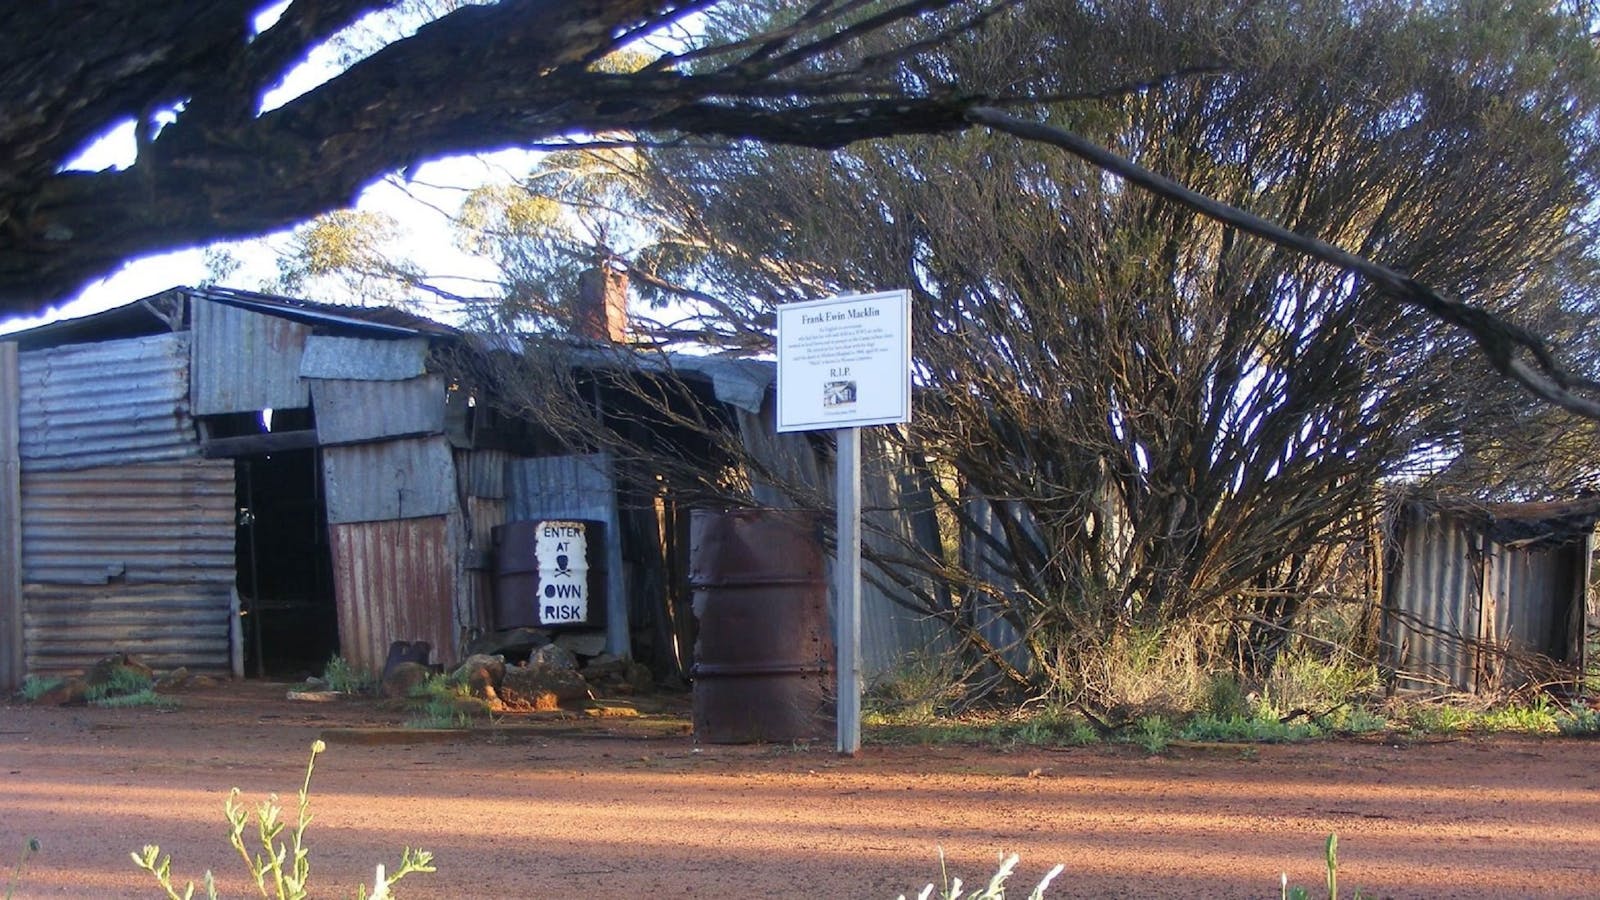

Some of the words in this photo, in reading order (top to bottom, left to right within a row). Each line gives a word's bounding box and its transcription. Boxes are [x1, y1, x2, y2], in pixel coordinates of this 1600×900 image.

[802, 313, 824, 325] Frank
[826, 311, 846, 322] Ewin
[847, 307, 880, 320] Macklin
[544, 527, 581, 538] ENTER
[556, 541, 570, 552] AT
[544, 584, 581, 599] OWN
[544, 605, 580, 620] RISK
